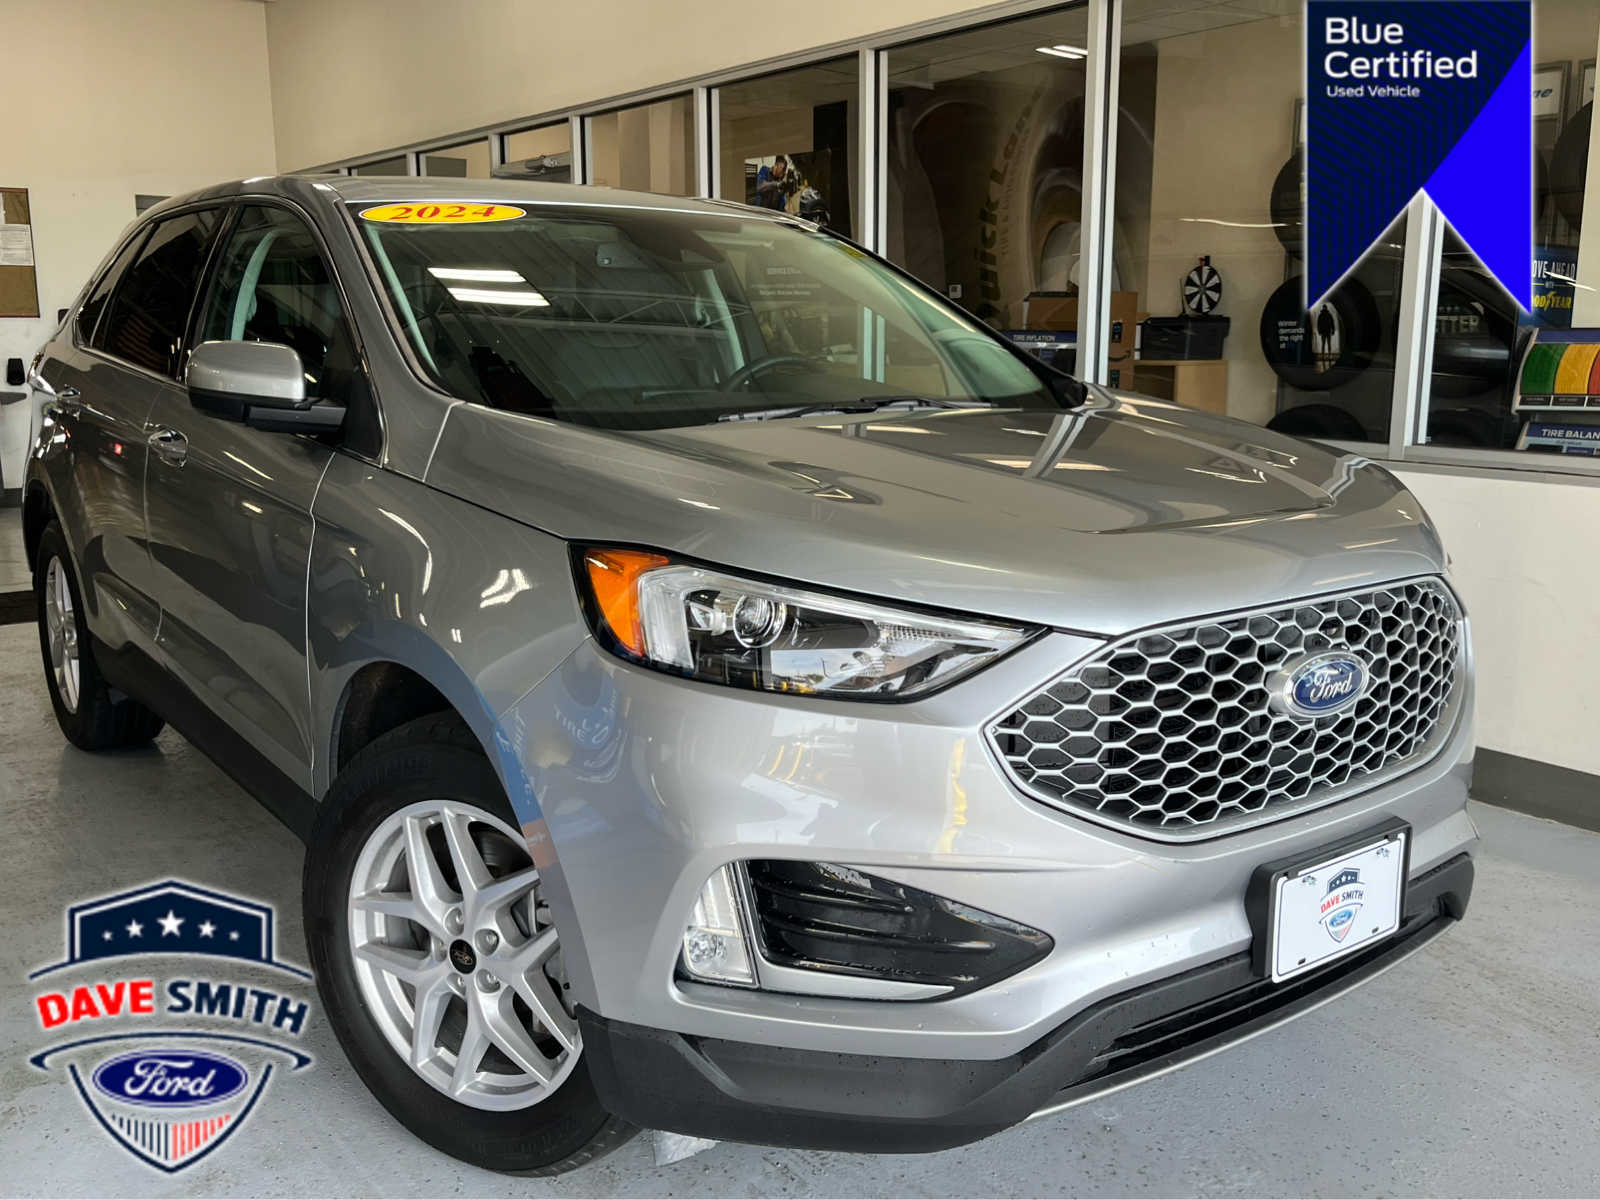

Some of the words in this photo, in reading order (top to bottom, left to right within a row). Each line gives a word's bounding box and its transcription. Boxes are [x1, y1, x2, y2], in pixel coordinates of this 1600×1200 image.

[389, 206, 496, 220] 2024
[1531, 260, 1549, 278] OVE
[1541, 428, 1565, 438] TIRE
[1309, 666, 1353, 702] Ford
[1320, 894, 1341, 914] DAVE
[1341, 890, 1363, 902] SMITH
